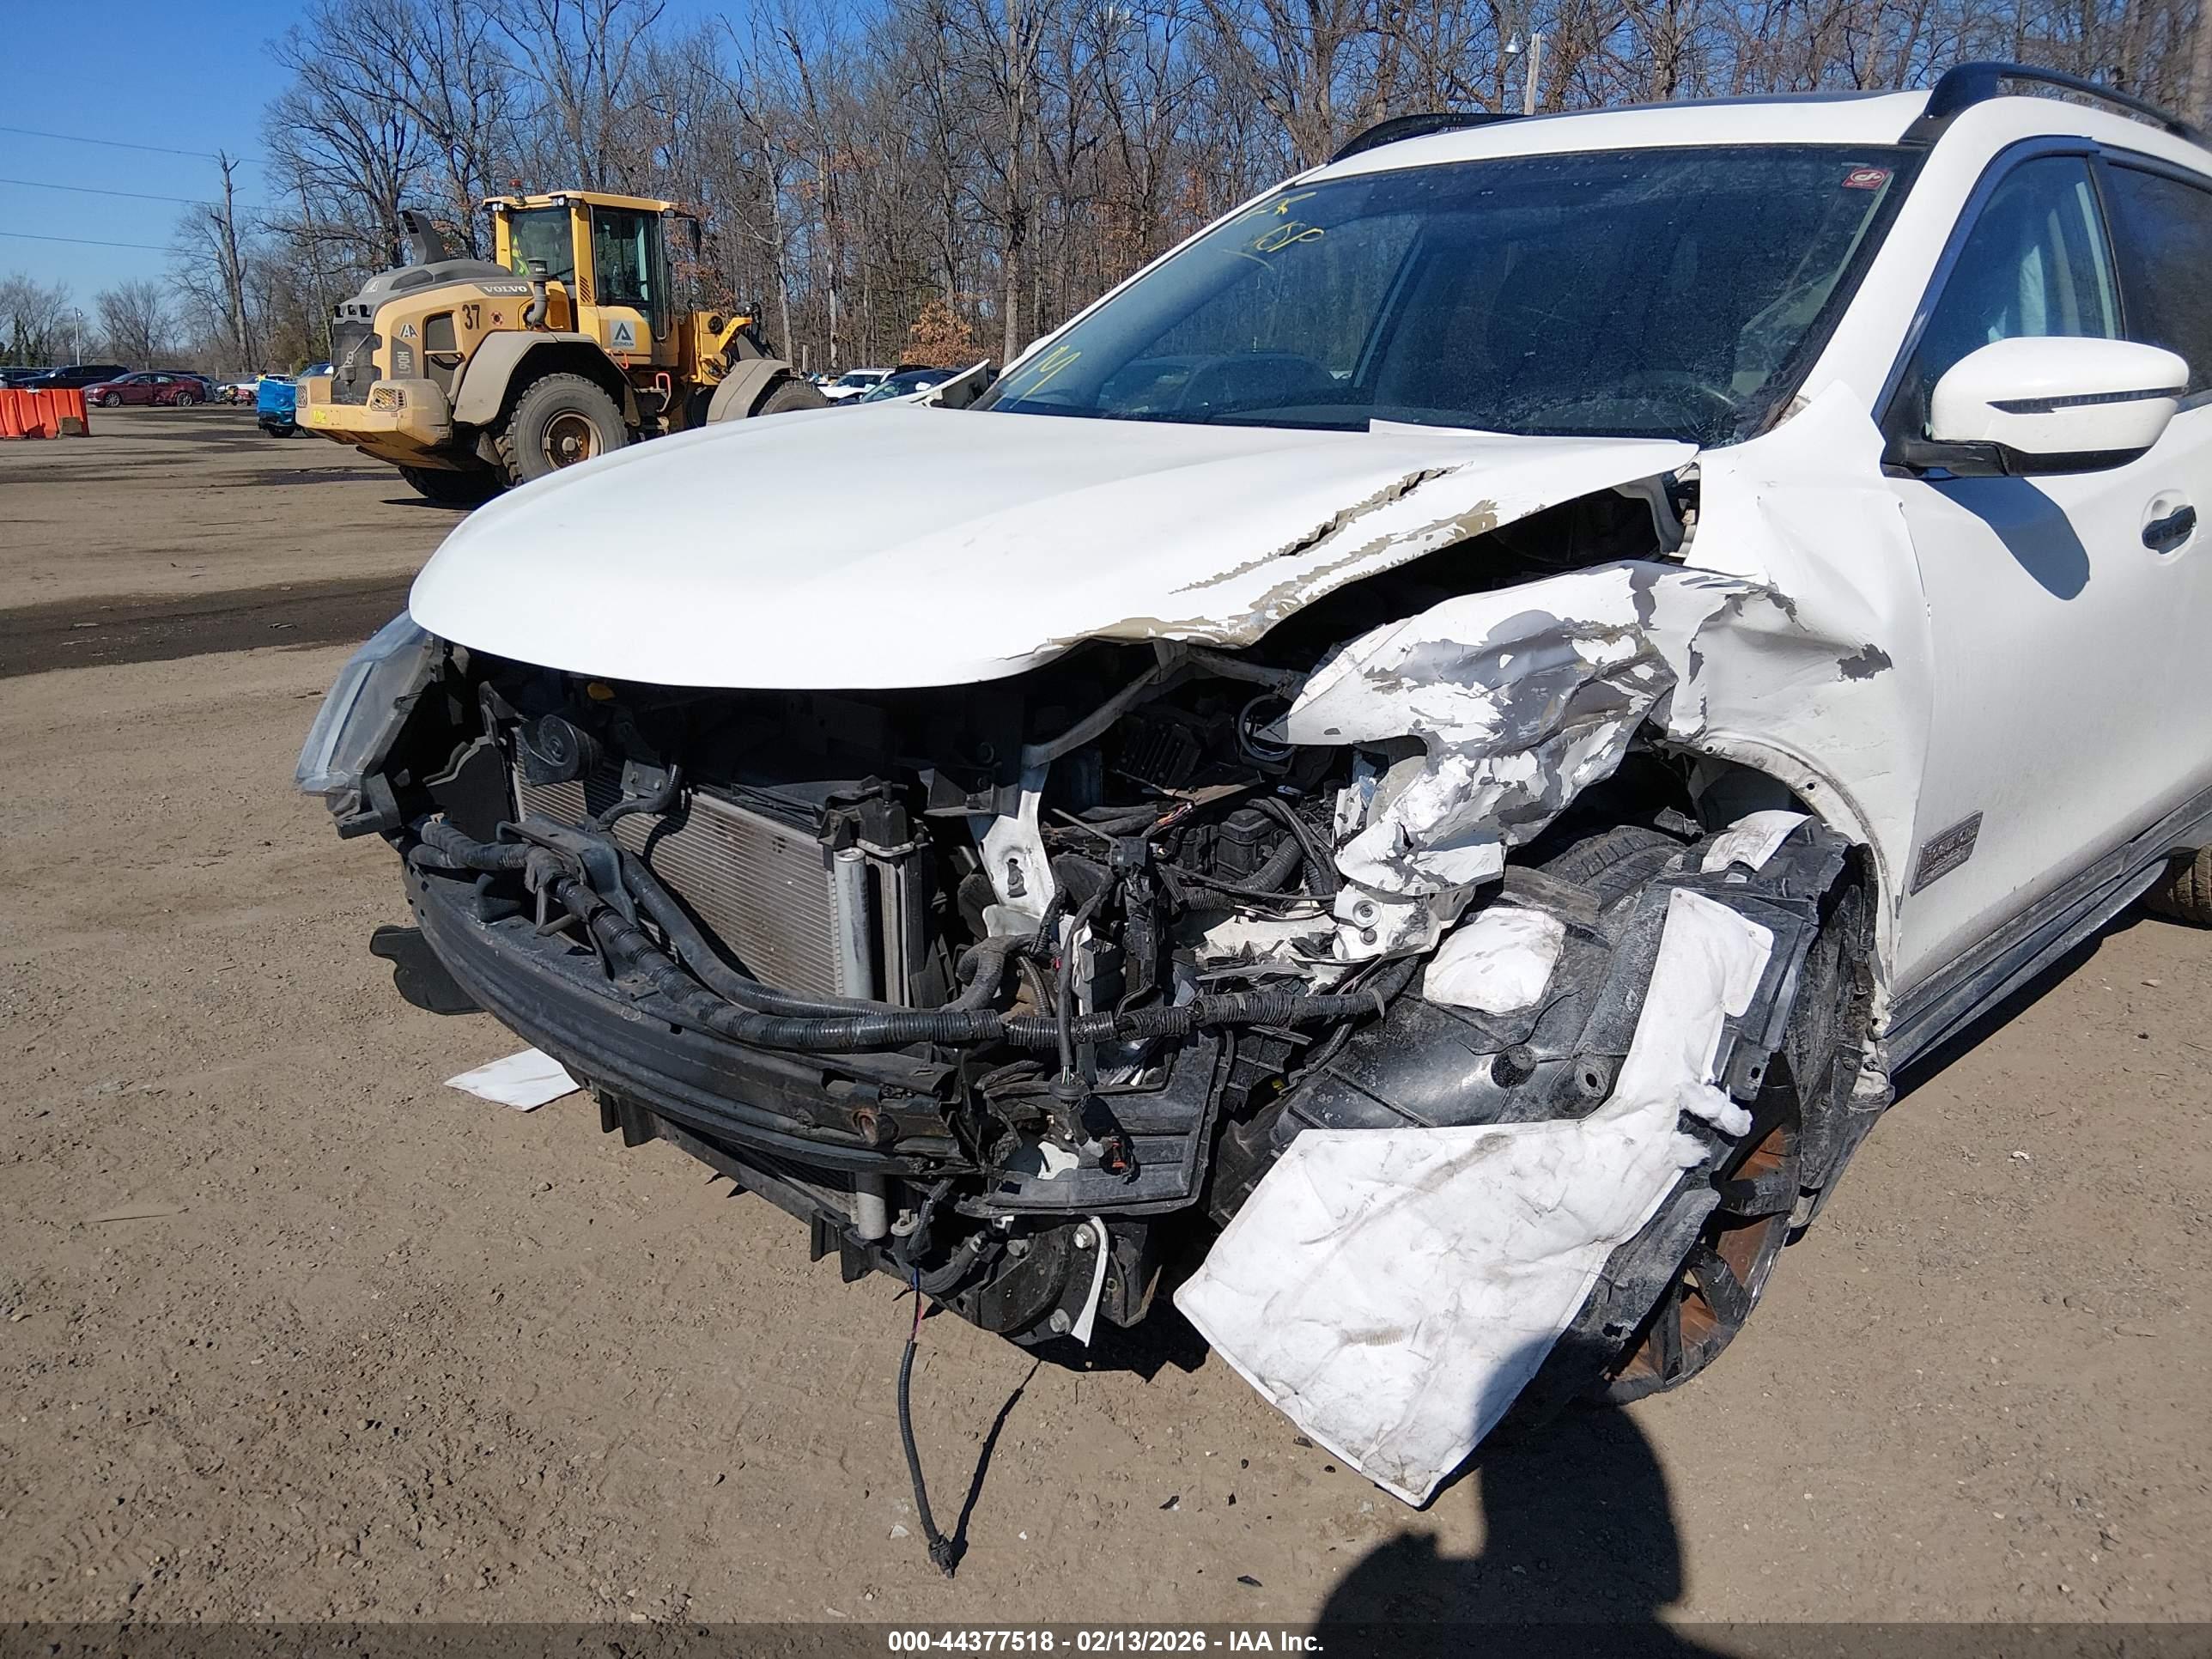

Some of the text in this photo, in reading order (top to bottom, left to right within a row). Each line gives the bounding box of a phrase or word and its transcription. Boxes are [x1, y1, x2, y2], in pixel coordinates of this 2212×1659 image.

[483, 285, 528, 294] VOLVO
[462, 304, 481, 331] 37
[397, 351, 412, 374] L90H
